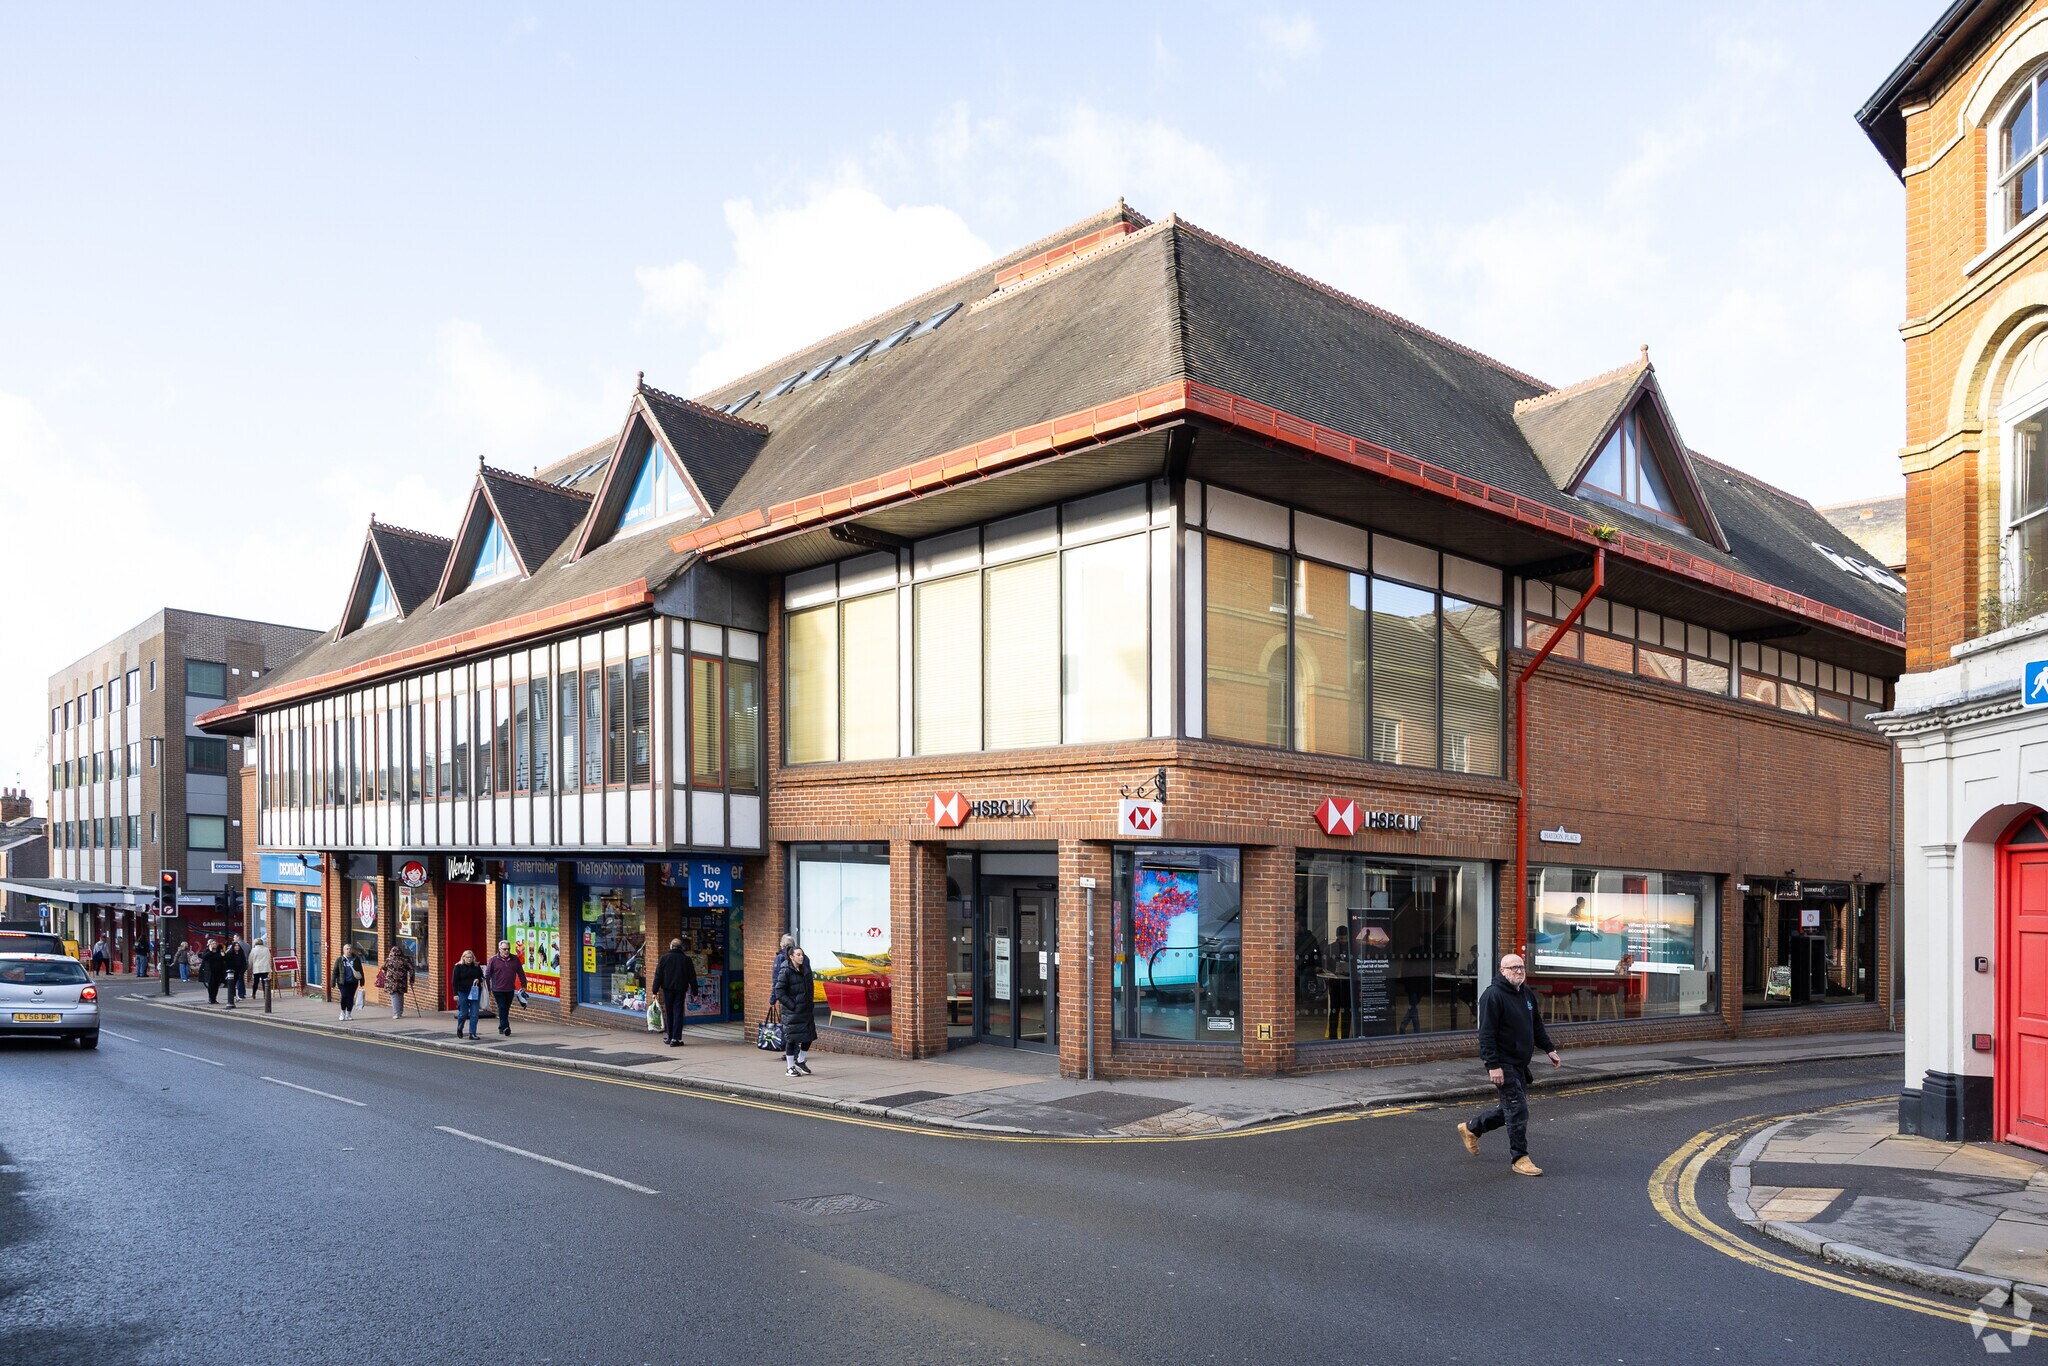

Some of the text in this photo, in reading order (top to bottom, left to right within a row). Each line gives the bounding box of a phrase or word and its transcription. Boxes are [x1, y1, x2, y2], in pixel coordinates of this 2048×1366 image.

[972, 799, 1035, 817] HSBC UK
[1365, 811, 1424, 831] HSBC UK
[448, 855, 475, 881] Wendy's
[517, 860, 558, 874] Entertainer
[576, 861, 645, 879] TheToyShop.com
[702, 864, 721, 875] The
[703, 878, 720, 891] Toy
[698, 892, 725, 905] Shop
[1259, 1024, 1271, 1039] H
